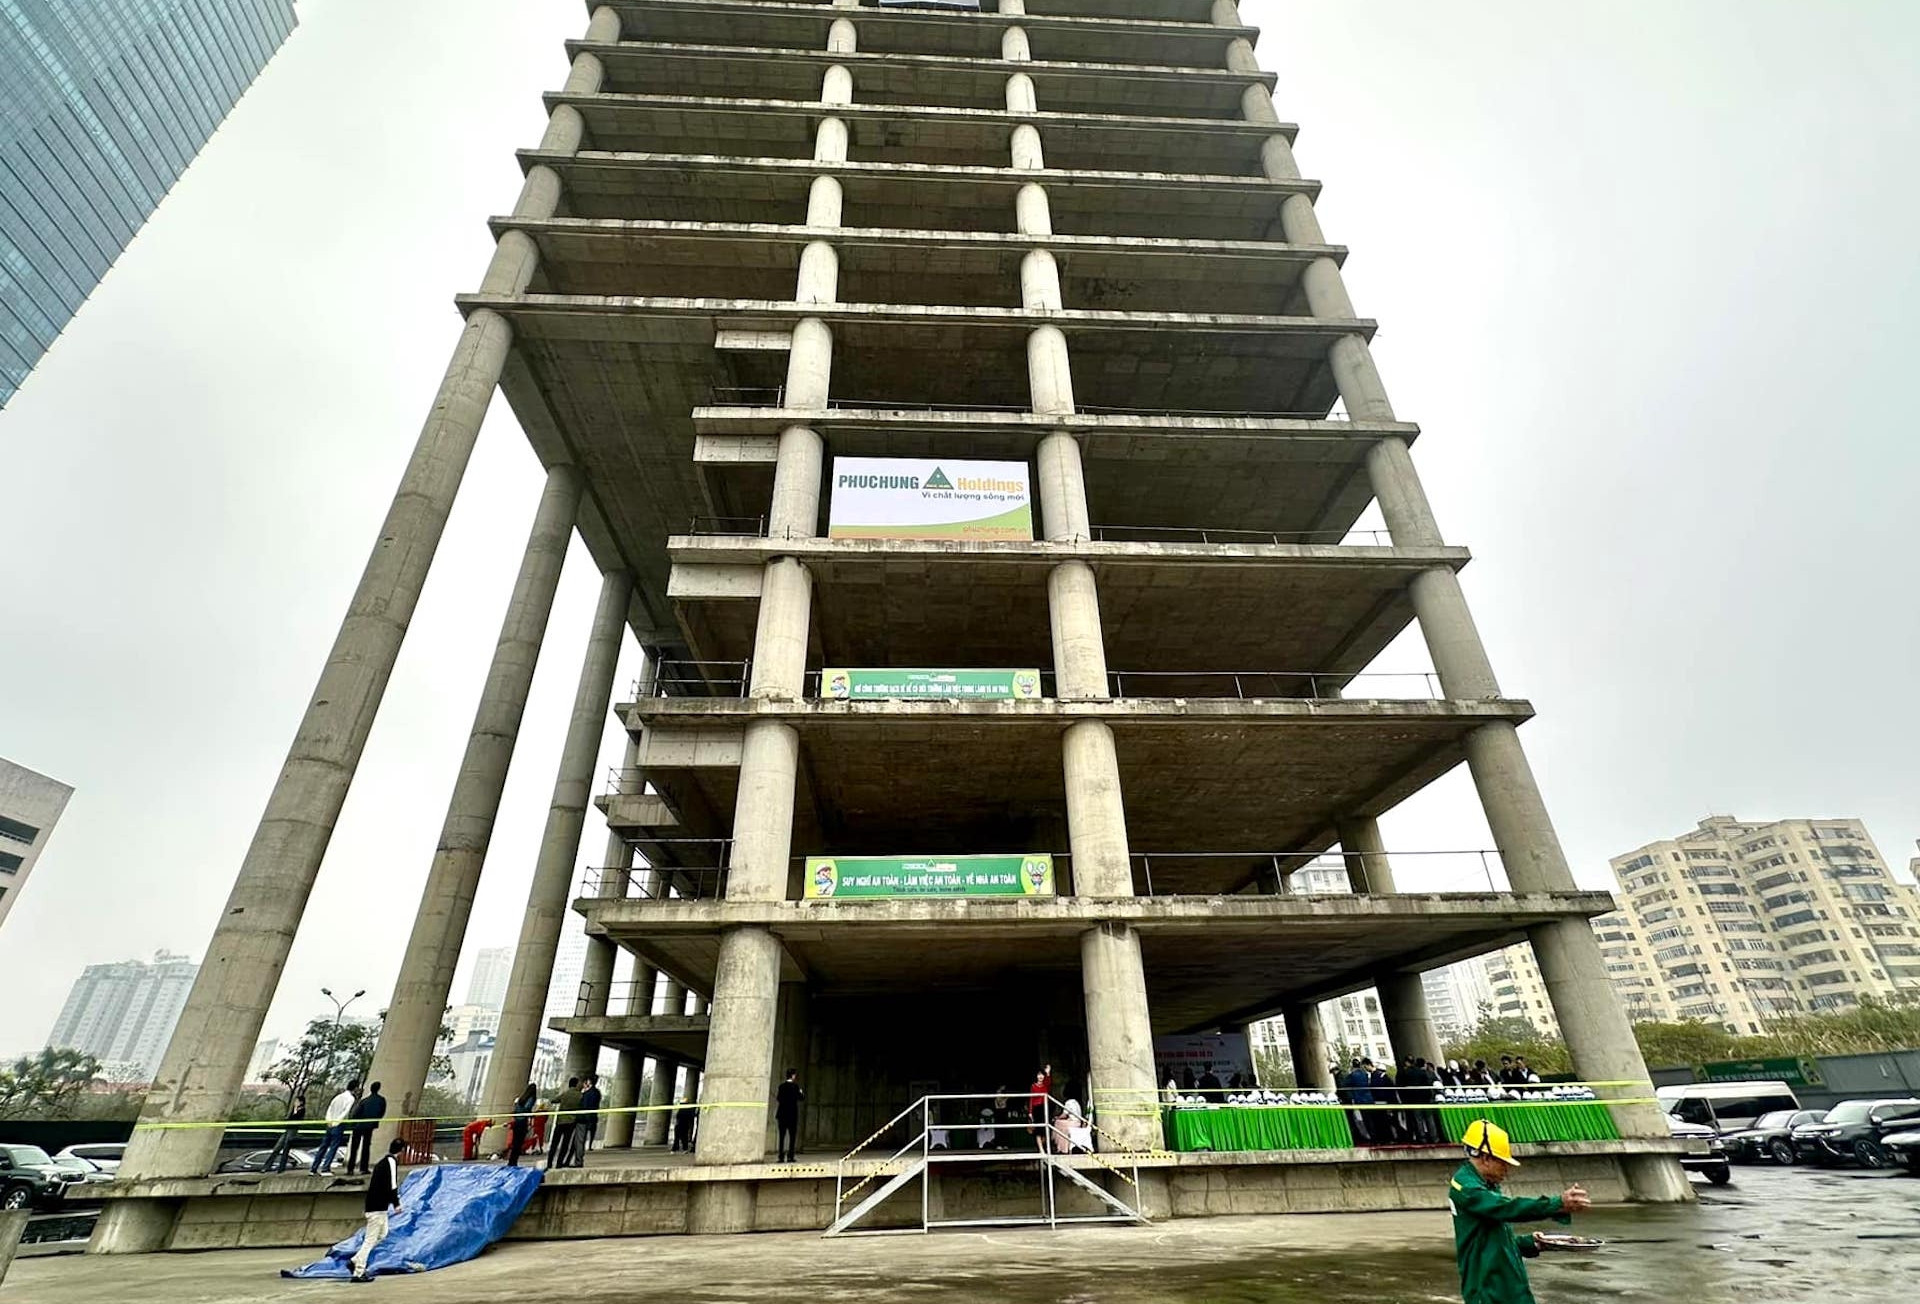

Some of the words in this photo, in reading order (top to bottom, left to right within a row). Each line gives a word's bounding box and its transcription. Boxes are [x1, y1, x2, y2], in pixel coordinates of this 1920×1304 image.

[838, 475, 919, 490] PHUCHUNG
[957, 477, 1024, 493] Holdings
[842, 876, 855, 886] SUY
[872, 876, 881, 886] AN
[882, 873, 899, 886] TOÀN
[904, 873, 918, 886] LÀM
[934, 875, 943, 885] AN
[944, 873, 961, 885] TOÀN
[990, 874, 999, 884] AN
[1000, 873, 1017, 884] TOÀN
